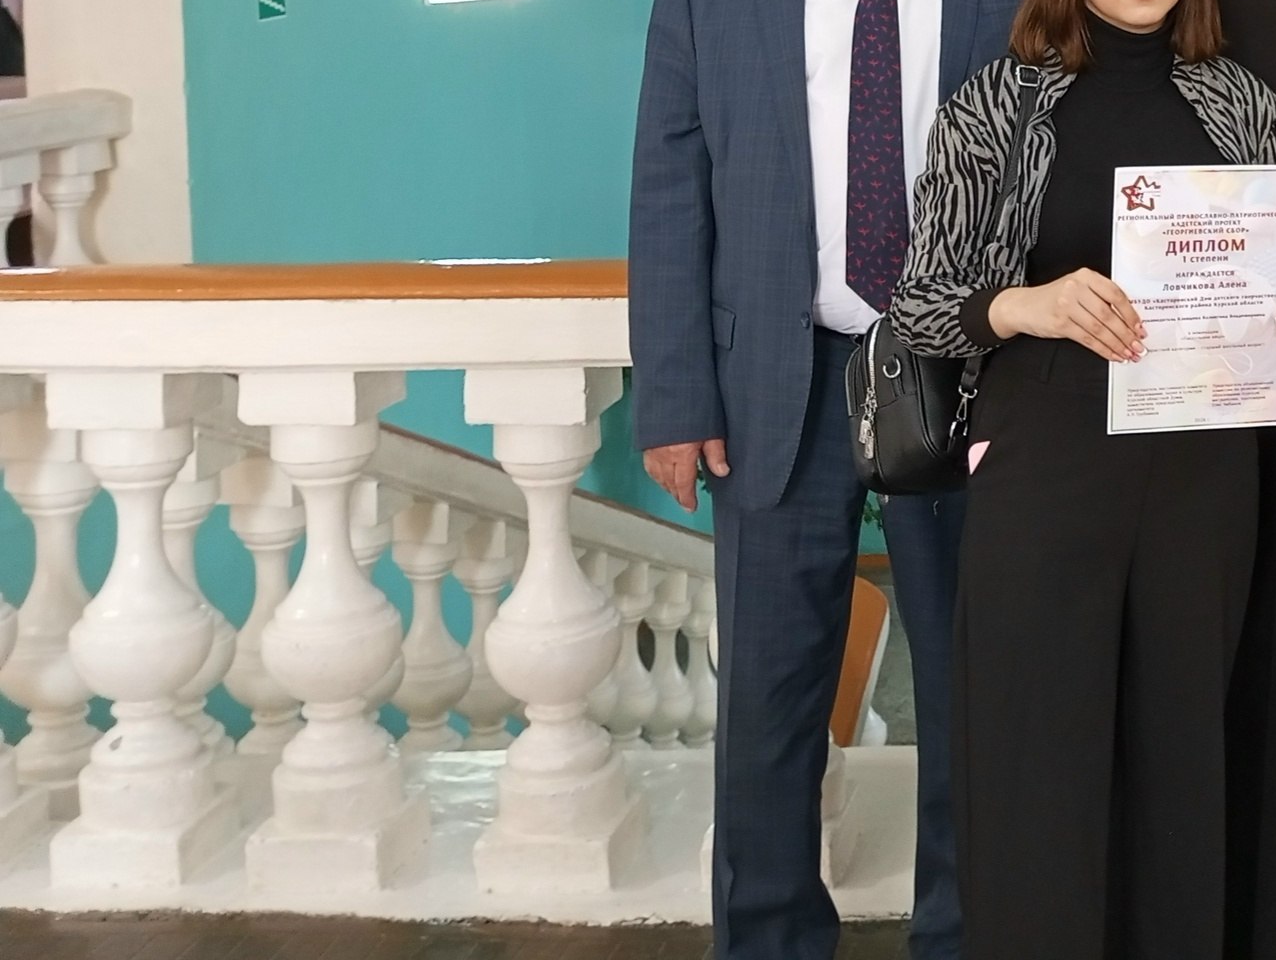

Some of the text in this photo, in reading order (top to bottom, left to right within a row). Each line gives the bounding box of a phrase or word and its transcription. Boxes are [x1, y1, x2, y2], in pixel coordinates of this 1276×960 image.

[1117, 213, 1175, 221] РЕГИОНАЛЬНЫЙ
[1214, 219, 1241, 227] ПРОЕКТ
[1165, 239, 1246, 256] ДИПЛОМ
[1190, 255, 1229, 263] степени
[1175, 270, 1235, 278] НАГРАЖДАЕТСЯ
[1162, 281, 1247, 292] Ловчикова Алена
